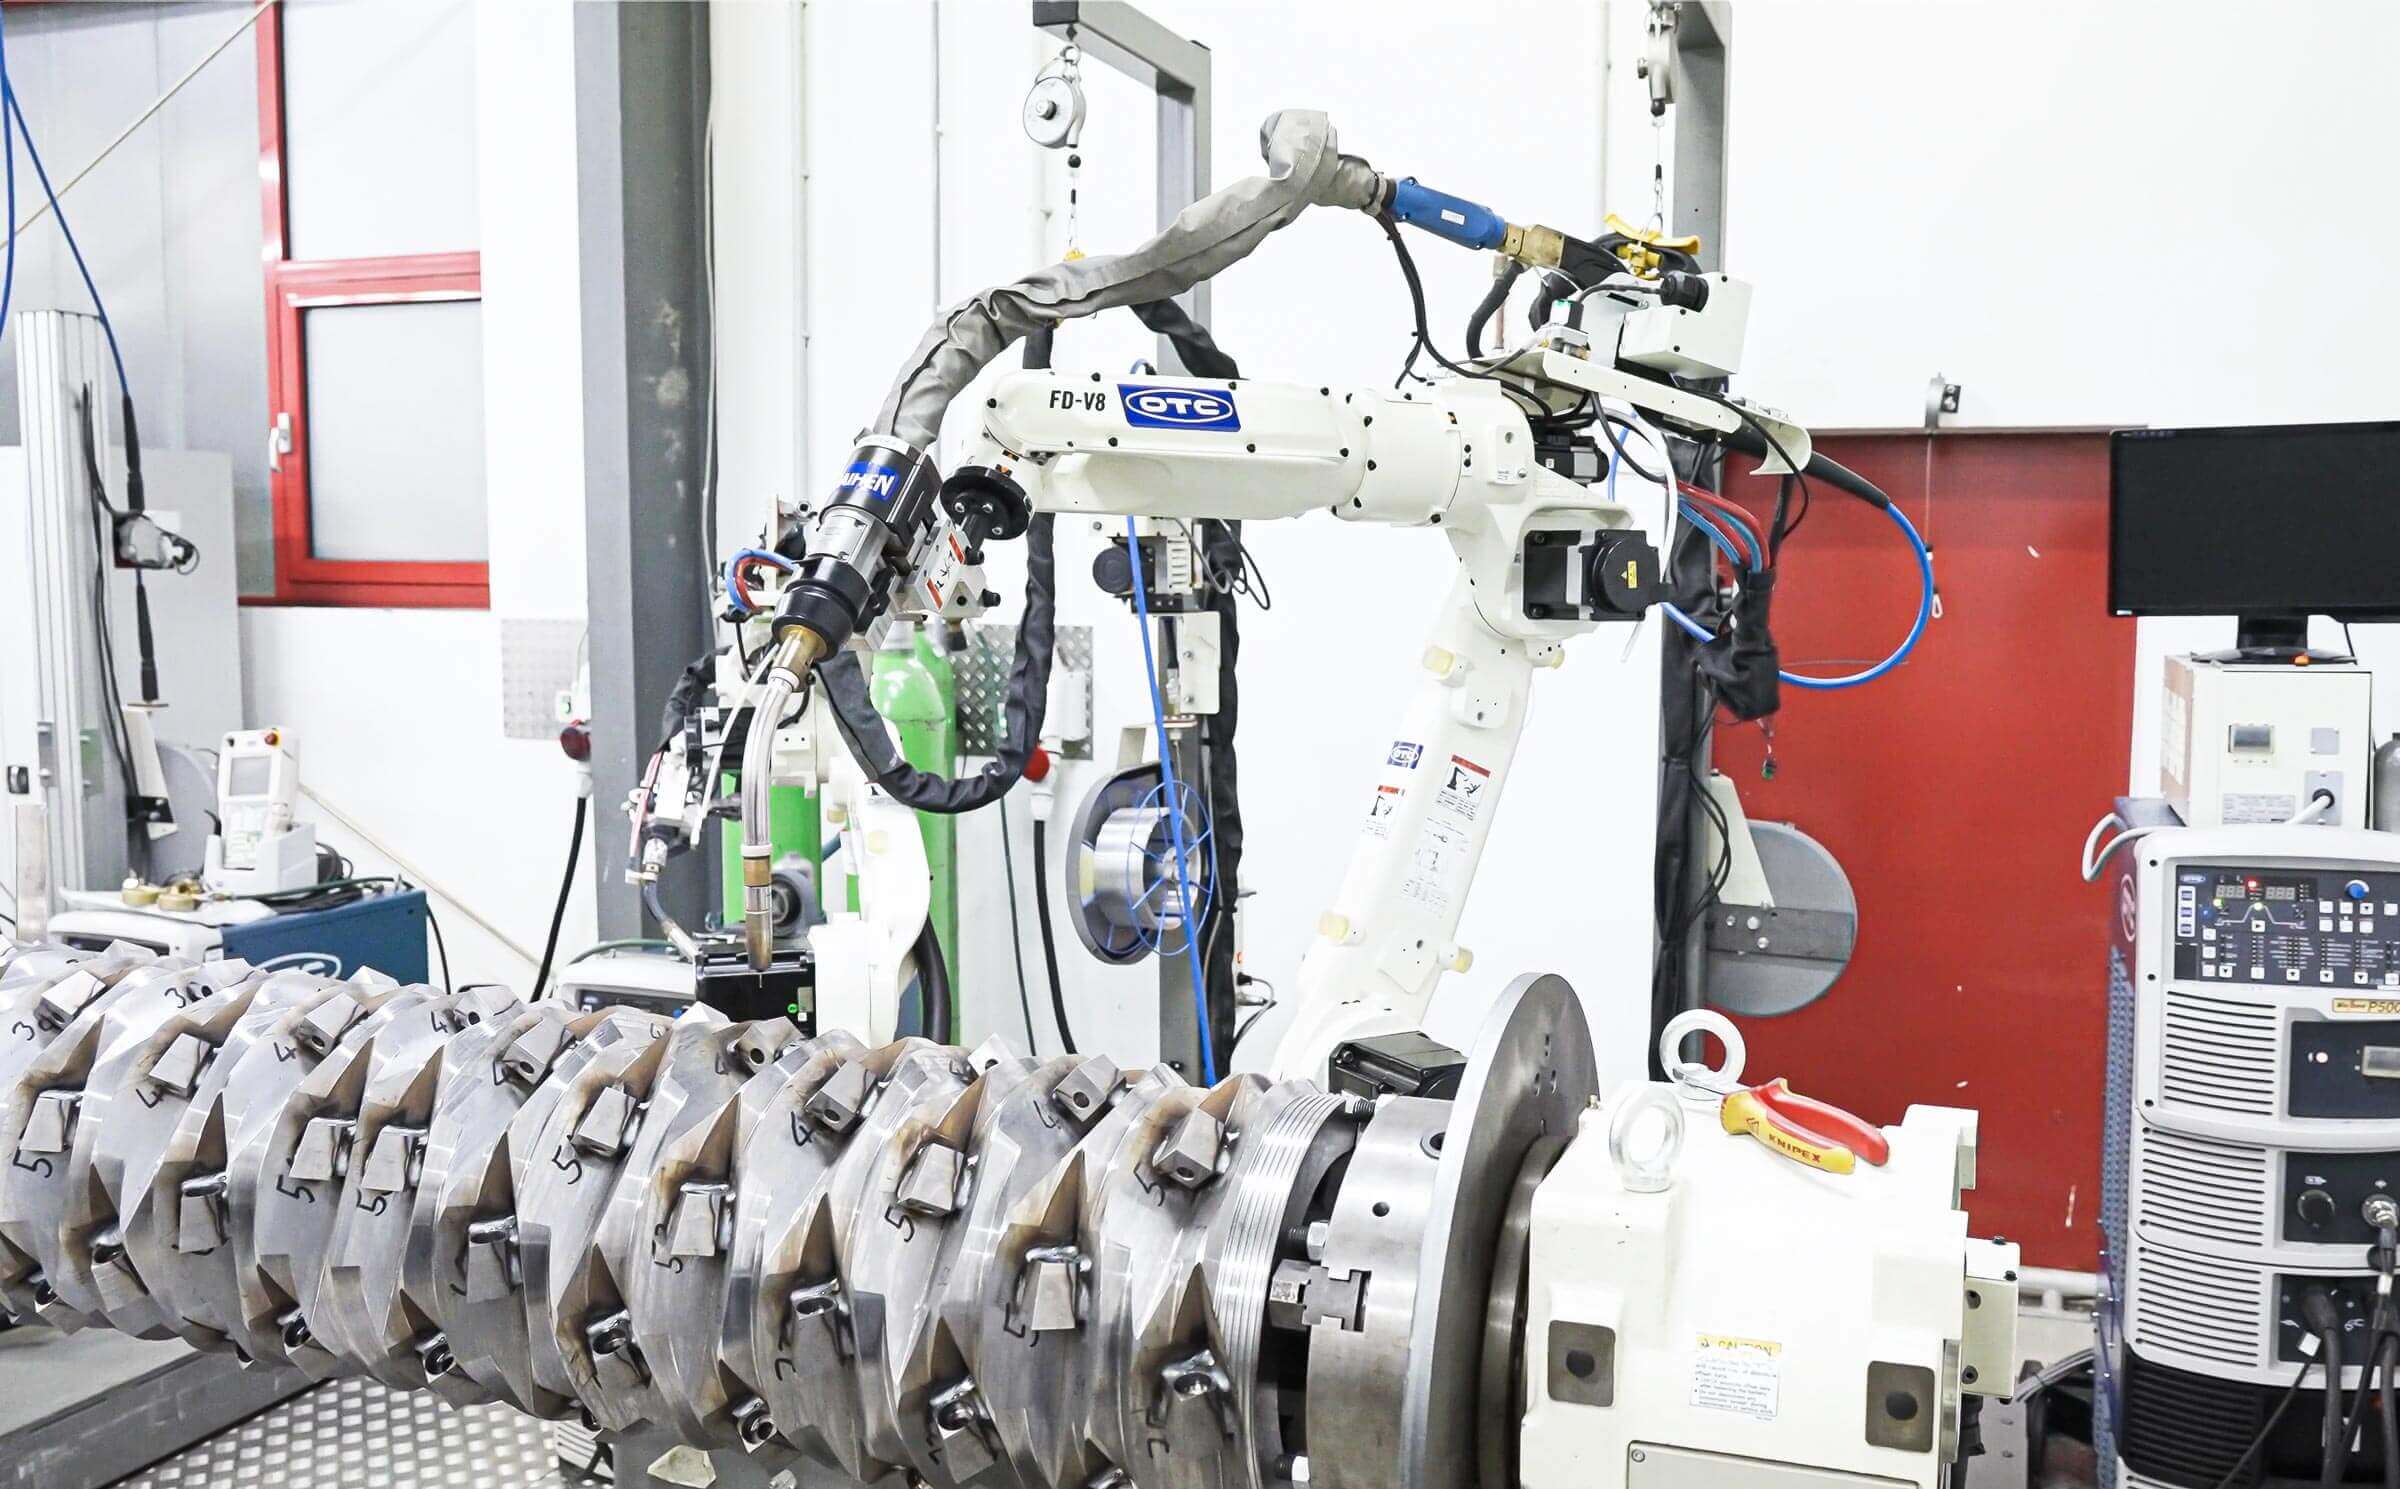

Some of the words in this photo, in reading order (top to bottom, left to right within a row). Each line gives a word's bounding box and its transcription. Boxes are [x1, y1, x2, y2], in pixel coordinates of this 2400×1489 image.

[1049, 389, 1106, 412] FD-V8
[1138, 396, 1221, 416] OTC
[164, 988, 186, 1009] 3
[12, 1020, 35, 1041] 3
[430, 1010, 449, 1033] 4
[273, 1041, 297, 1062] 4
[790, 1110, 816, 1147] 4
[13, 1146, 53, 1179] 5
[1768, 1133, 1821, 1163] KNIPEX
[551, 1144, 583, 1185] 5
[276, 1174, 315, 1204] 5
[1133, 1161, 1165, 1207] 5
[356, 1188, 388, 1217] 5
[885, 1205, 916, 1243] 5
